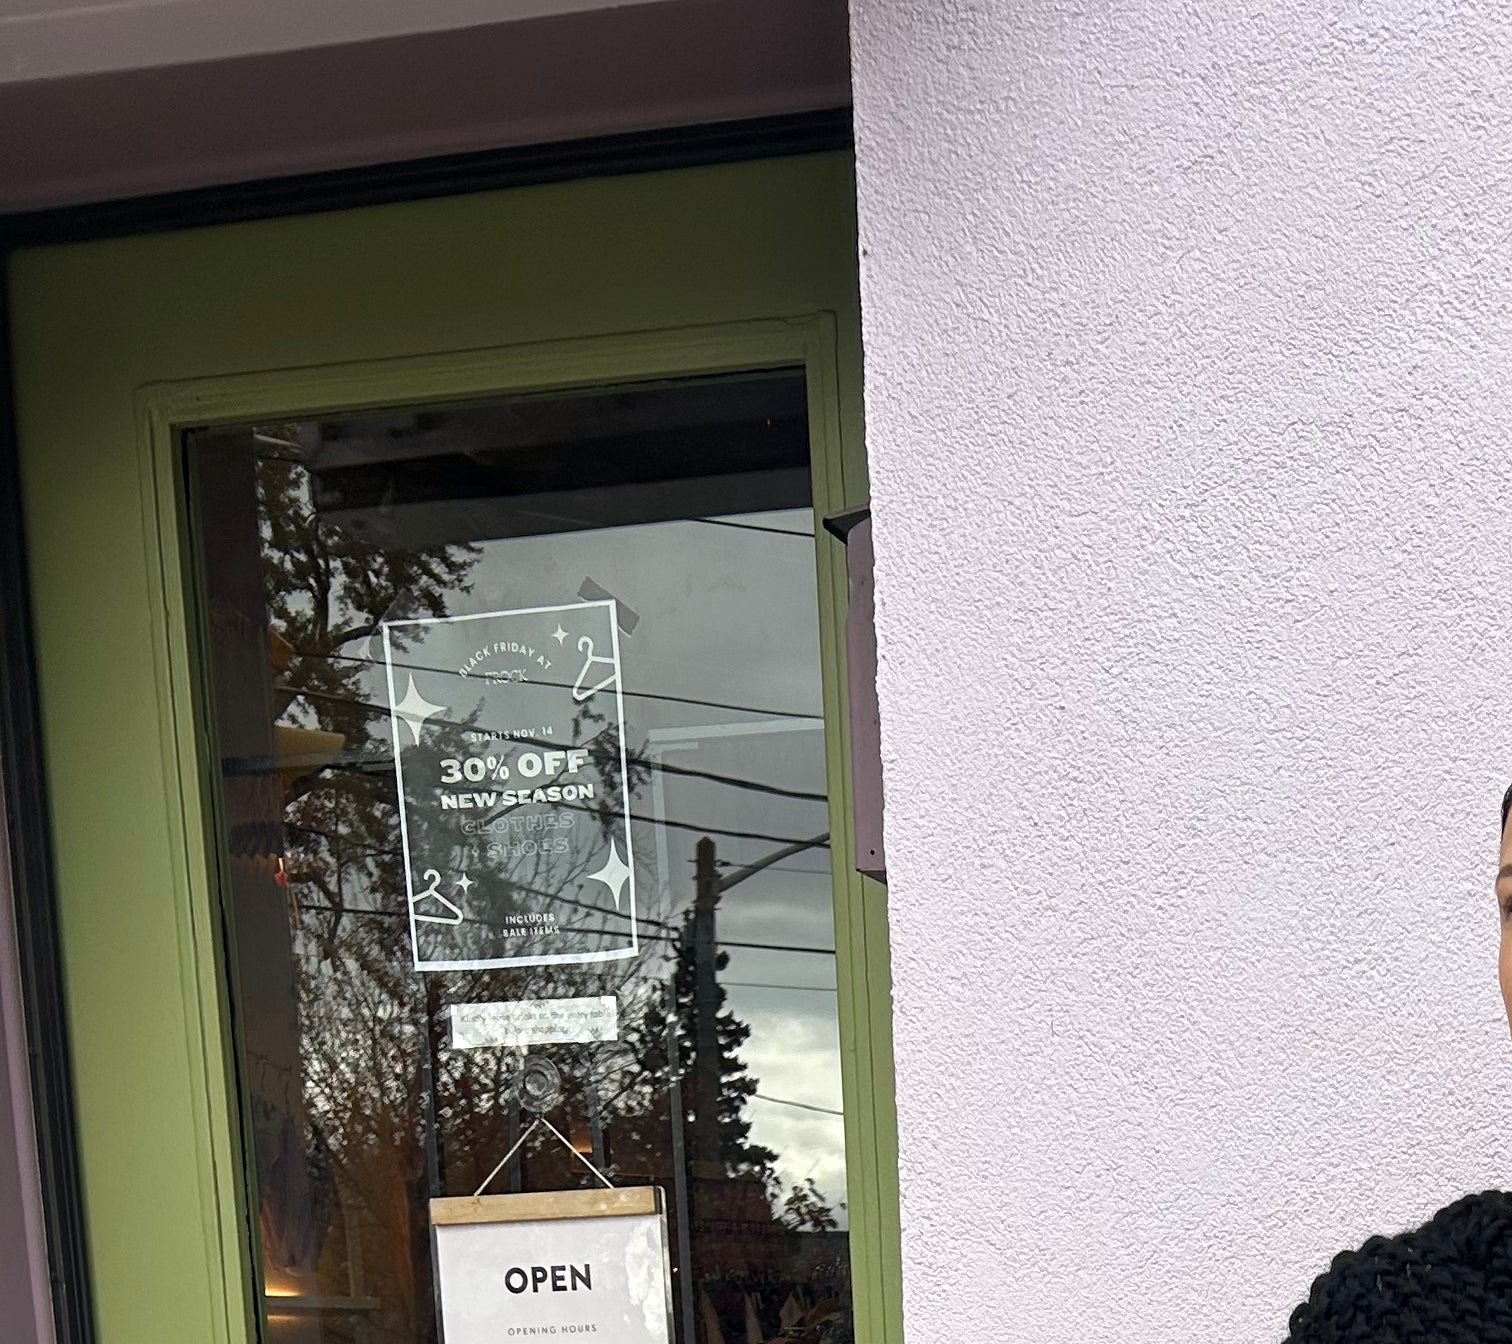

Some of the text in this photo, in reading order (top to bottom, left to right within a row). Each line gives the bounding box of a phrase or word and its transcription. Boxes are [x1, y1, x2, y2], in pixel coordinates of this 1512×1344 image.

[458, 641, 552, 679] BLACK FRIDAY AT
[470, 726, 553, 743] STARTS NOV. 14
[439, 749, 589, 784] 30% OFF
[440, 783, 595, 810] NEW SEASON
[461, 811, 576, 836] CLOTHES
[486, 837, 570, 859] SHOES
[505, 912, 555, 925] INCLUDES
[502, 925, 560, 938] SALE ITEMS
[504, 1263, 592, 1294] OPEN
[507, 1323, 597, 1336] OPENING HOURS
